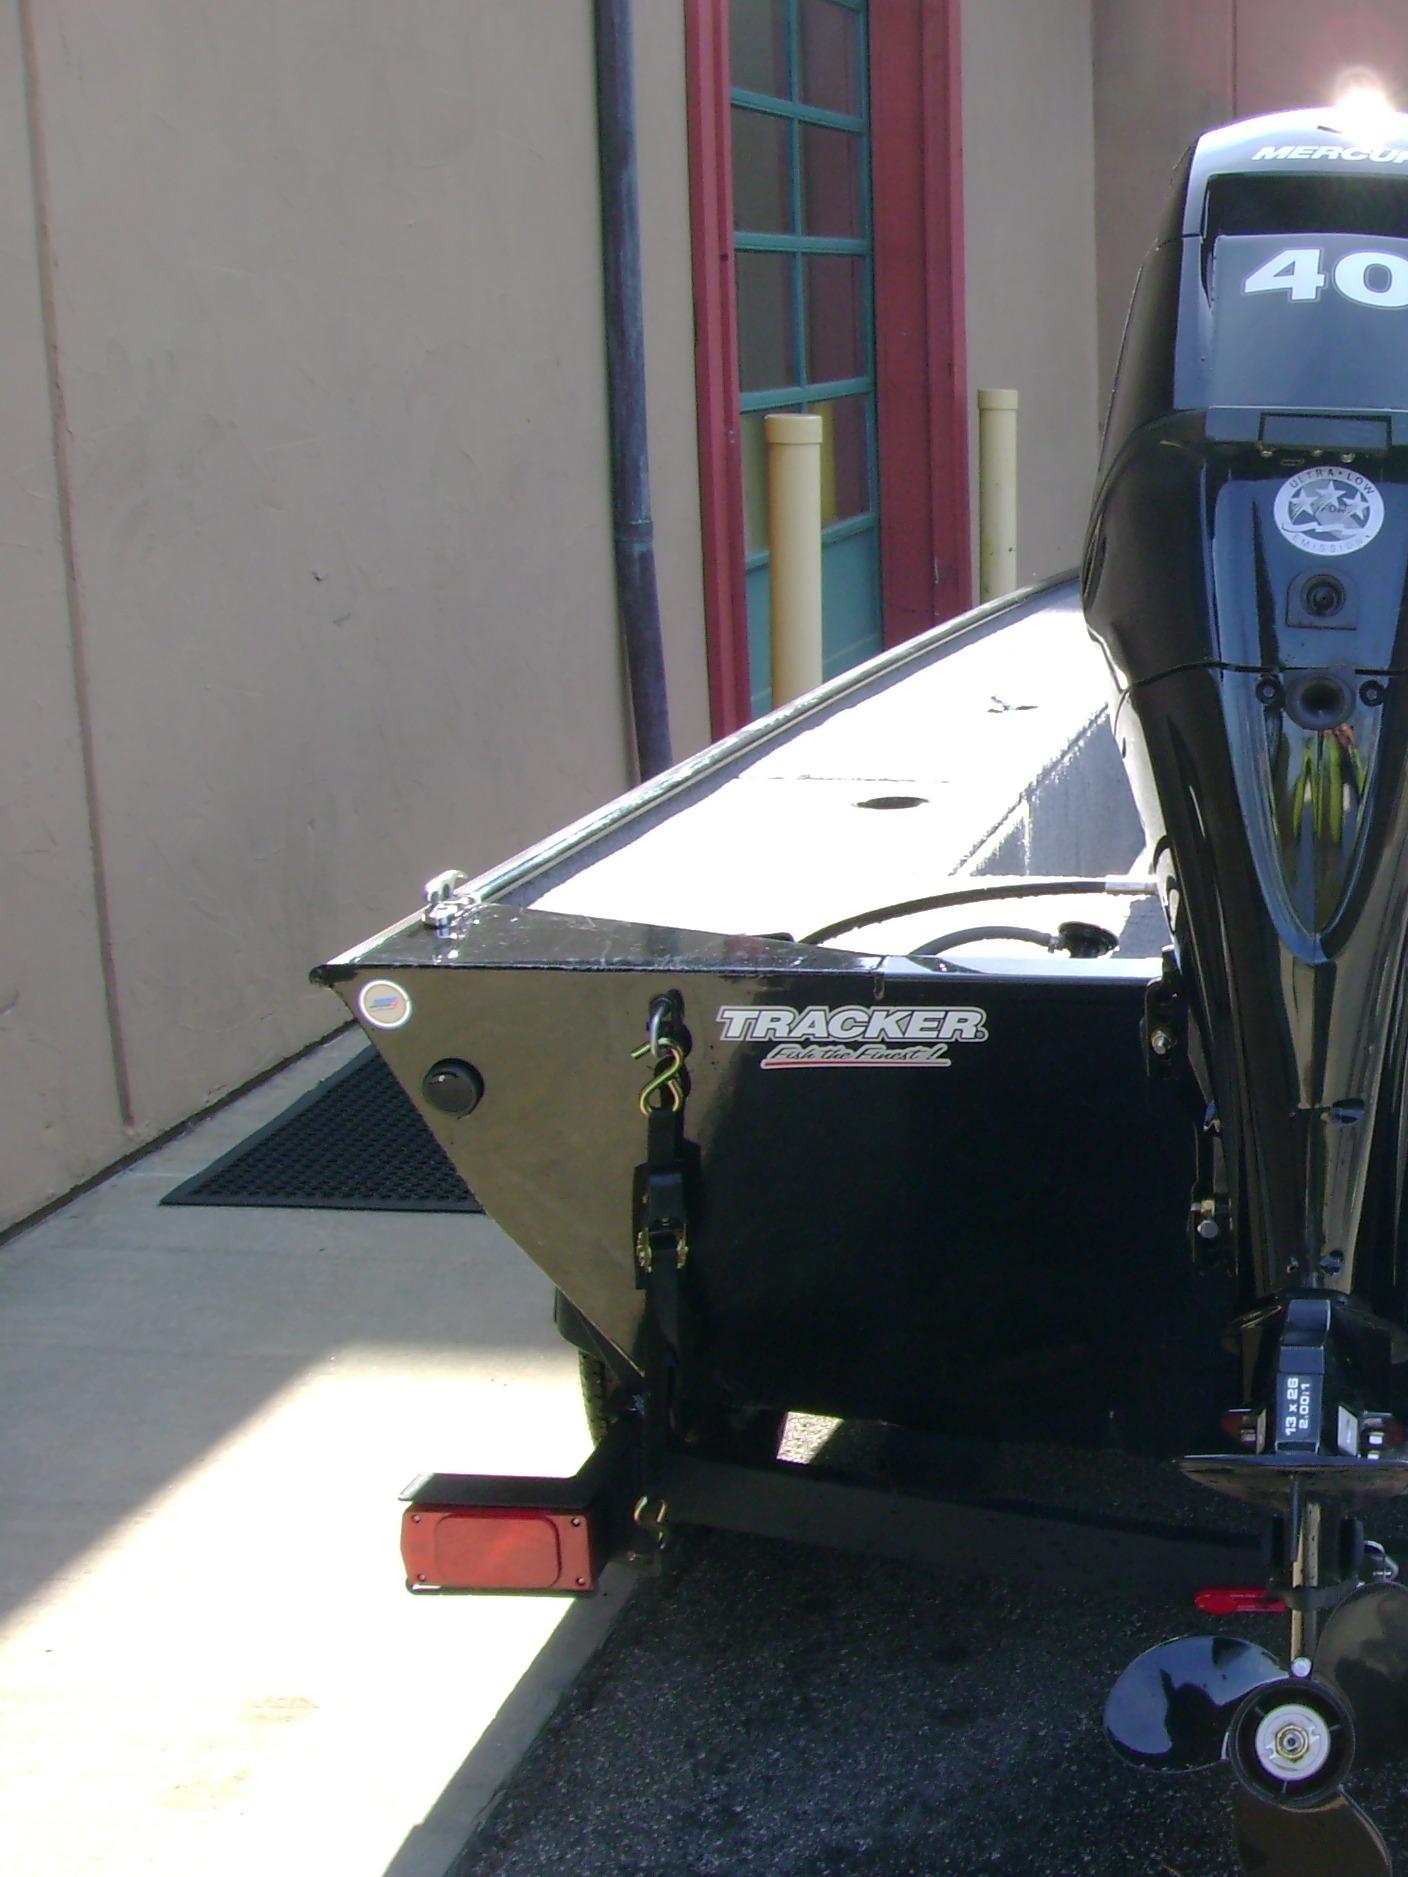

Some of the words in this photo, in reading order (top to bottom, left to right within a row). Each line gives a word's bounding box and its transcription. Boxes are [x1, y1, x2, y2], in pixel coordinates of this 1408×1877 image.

[1347, 473, 1375, 494] LOW
[718, 1006, 982, 1040] TRACKER
[771, 1046, 815, 1060] Fish
[820, 1047, 851, 1060] the
[1286, 1377, 1299, 1400] 26
[1285, 1416, 1297, 1436] 13
